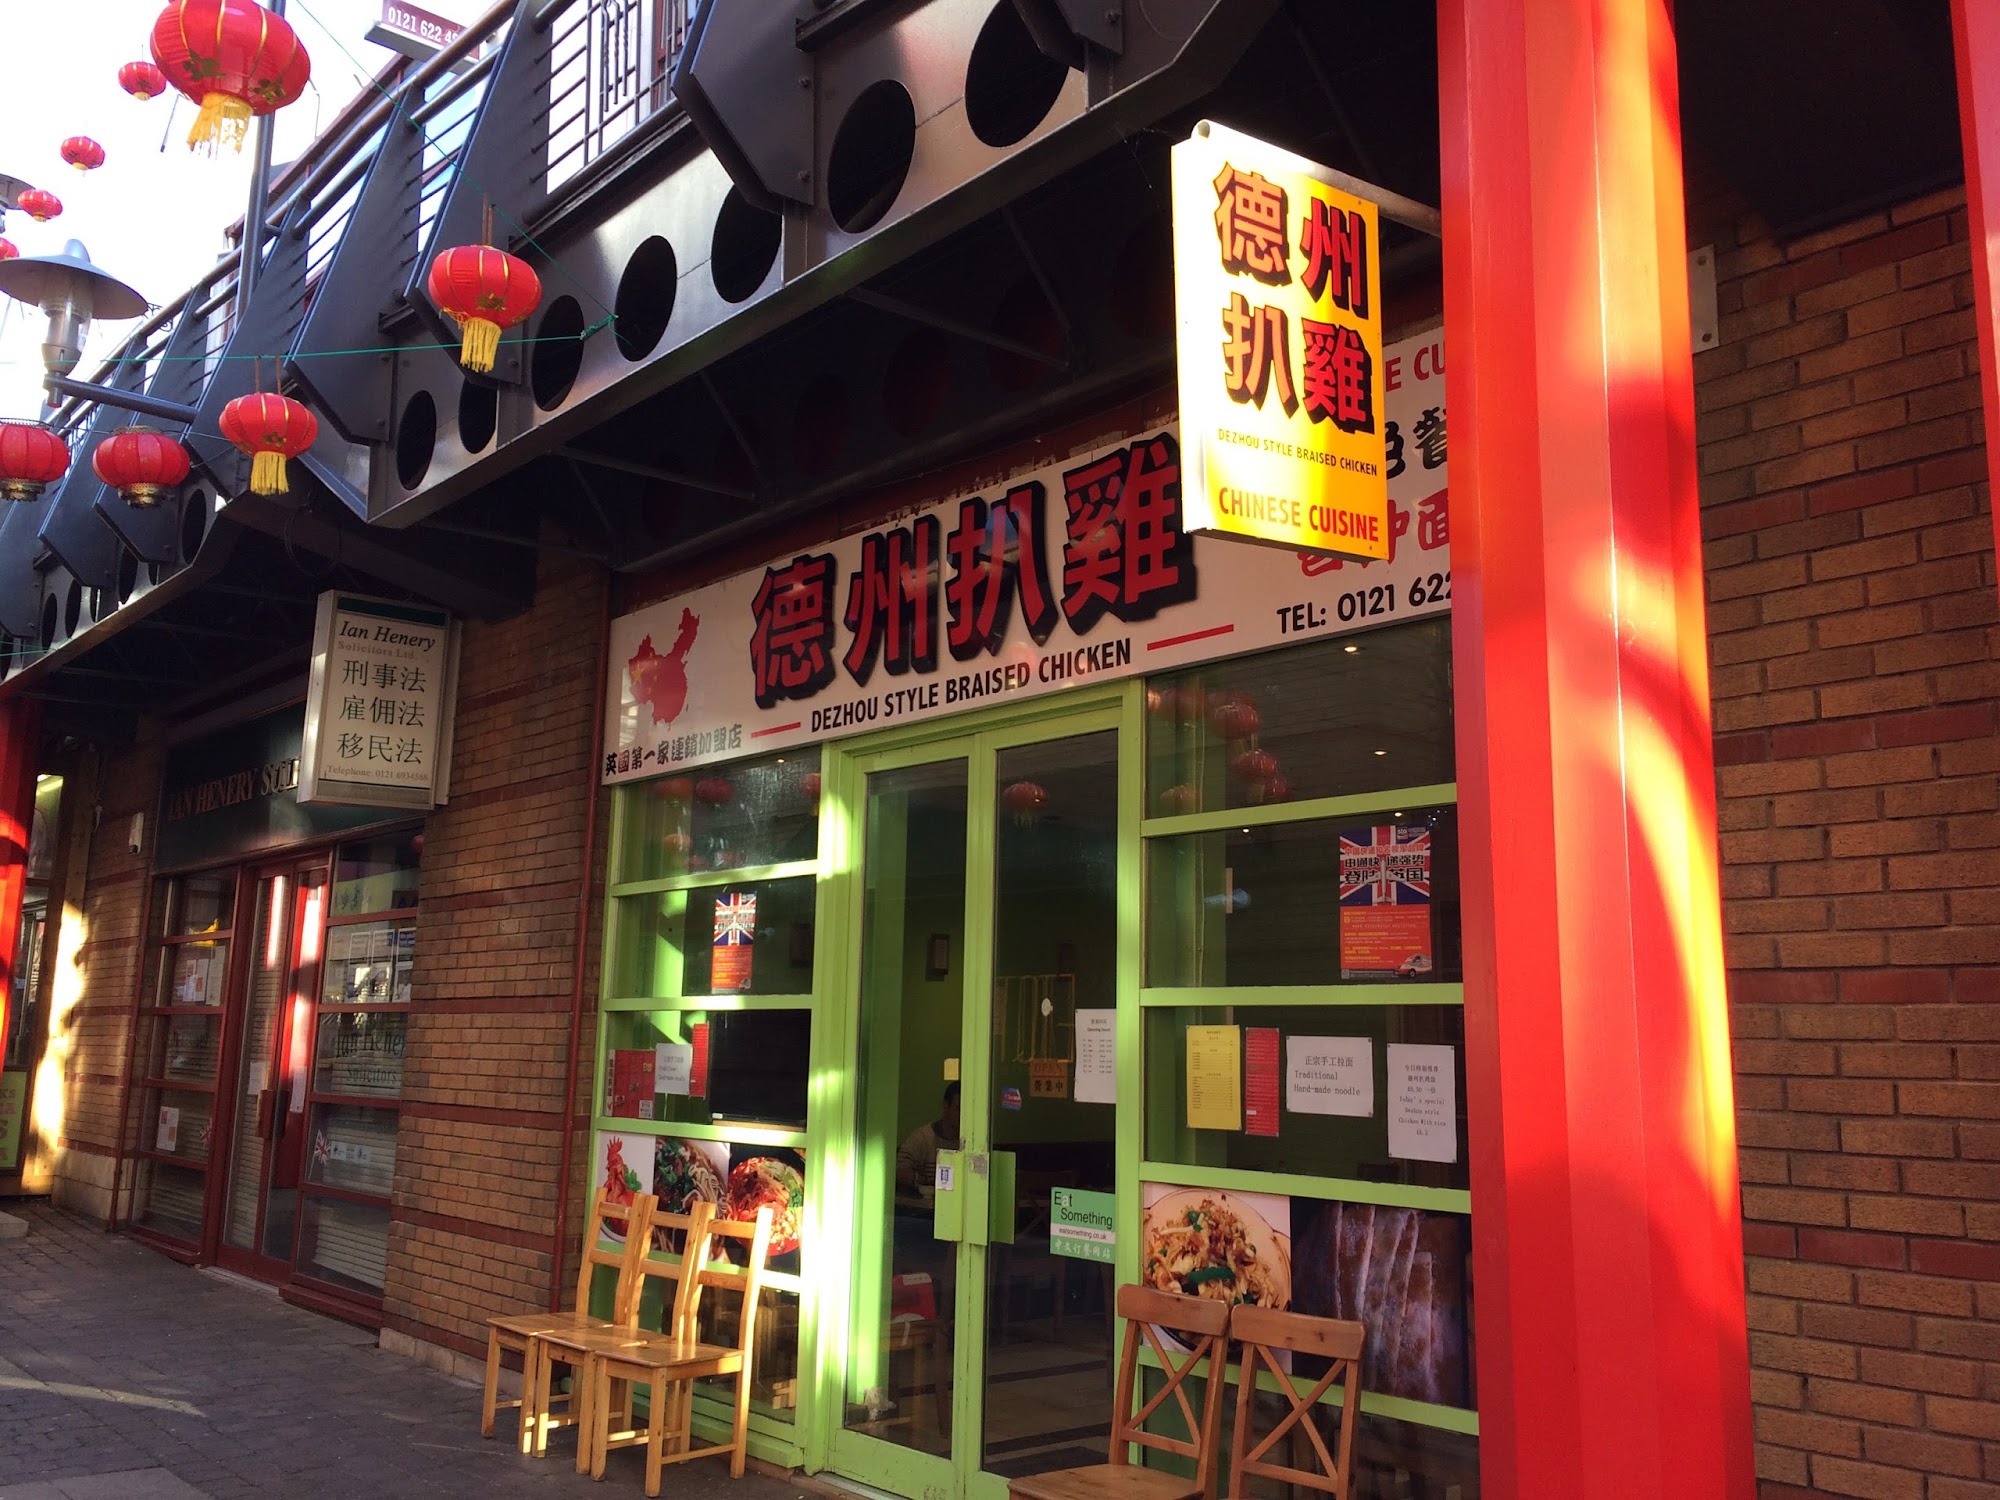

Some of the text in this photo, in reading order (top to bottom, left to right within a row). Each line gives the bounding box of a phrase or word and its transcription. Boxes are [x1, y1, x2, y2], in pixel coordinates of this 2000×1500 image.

[387, 6, 417, 33] 0121
[420, 20, 443, 43] 622
[1213, 161, 1369, 320] 德州
[1222, 291, 1375, 434] 扒雞
[1218, 428, 1377, 476] DEZHOU STYLE BRAISED CHICKEN
[1218, 486, 1301, 527] CHINESE
[1309, 504, 1379, 542] CUISINE
[750, 432, 1197, 709] 德州扒雞
[1276, 601, 1326, 634] TEL:
[1337, 583, 1395, 622] 0121
[337, 641, 393, 659] Solicitors
[339, 620, 436, 653] Ian Henery
[341, 659, 427, 694] 刑事法
[811, 637, 1132, 733] DEZHOU STYLE BRAISED CHICKEN
[338, 695, 425, 728] 雇佣法
[336, 732, 423, 765] 移民法
[194, 766, 259, 815] HENERY
[374, 769, 395, 780] 0121
[1294, 1083, 1361, 1096] Hand-made noodle
[1295, 1070, 1338, 1080] Traditional
[1054, 1191, 1073, 1208] Eat
[1060, 1207, 1113, 1230] Something
